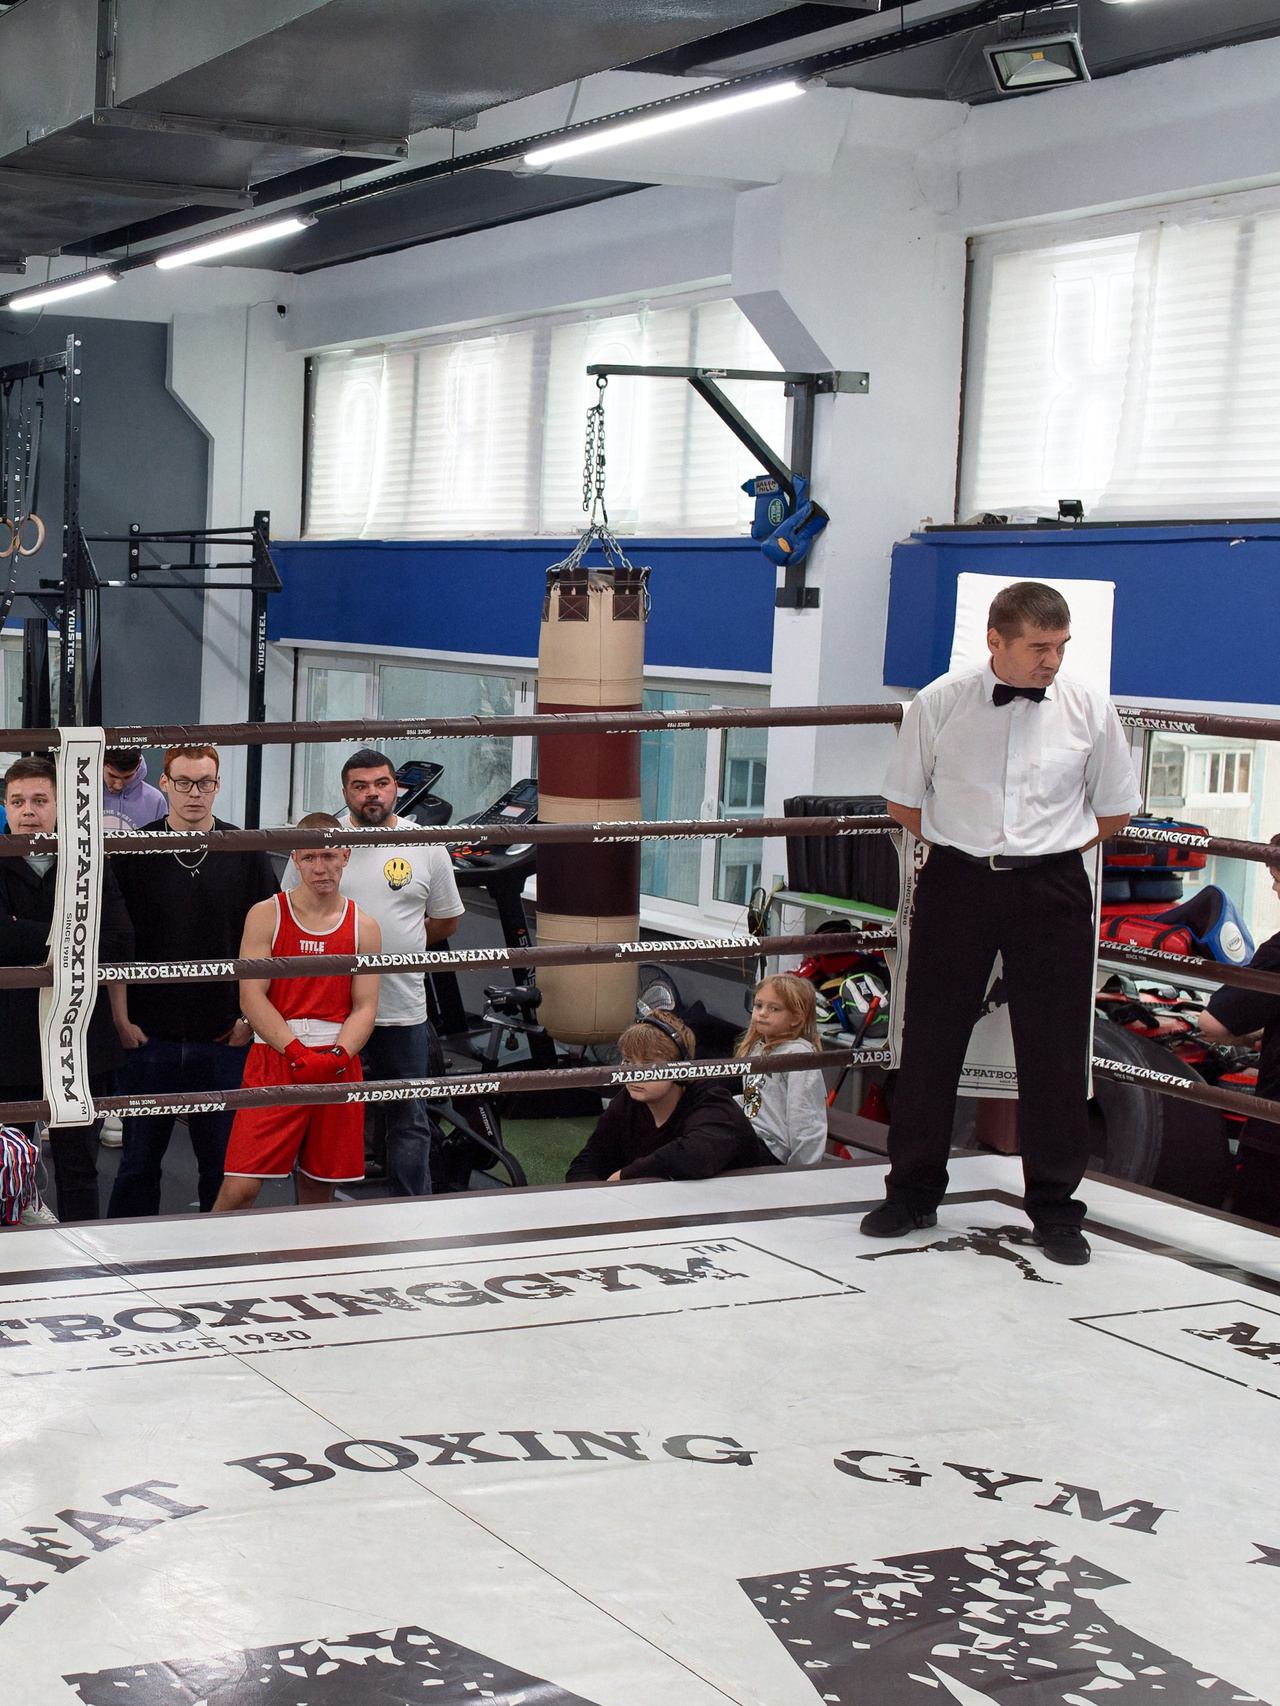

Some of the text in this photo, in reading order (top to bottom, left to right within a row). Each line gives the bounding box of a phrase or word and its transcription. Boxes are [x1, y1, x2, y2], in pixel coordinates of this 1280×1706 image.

[67, 609, 76, 672] YOUSTEEL
[257, 612, 266, 673] YOUSTEEL
[57, 756, 91, 1103] MAYFATBOXINGGYM
[62, 944, 70, 969] 1980
[300, 940, 325, 952] TITLE
[356, 948, 510, 968] MAYFATBOXINGGYM
[611, 1062, 751, 1084] MAYFATBOXINGGYM
[346, 1081, 500, 1102] MAYFATBOXINGGYM
[689, 1244, 733, 1254] TM
[110, 1329, 313, 1359] SINCE 1980
[225, 1431, 759, 1492] BOXING
[833, 1449, 1179, 1535] GYM
